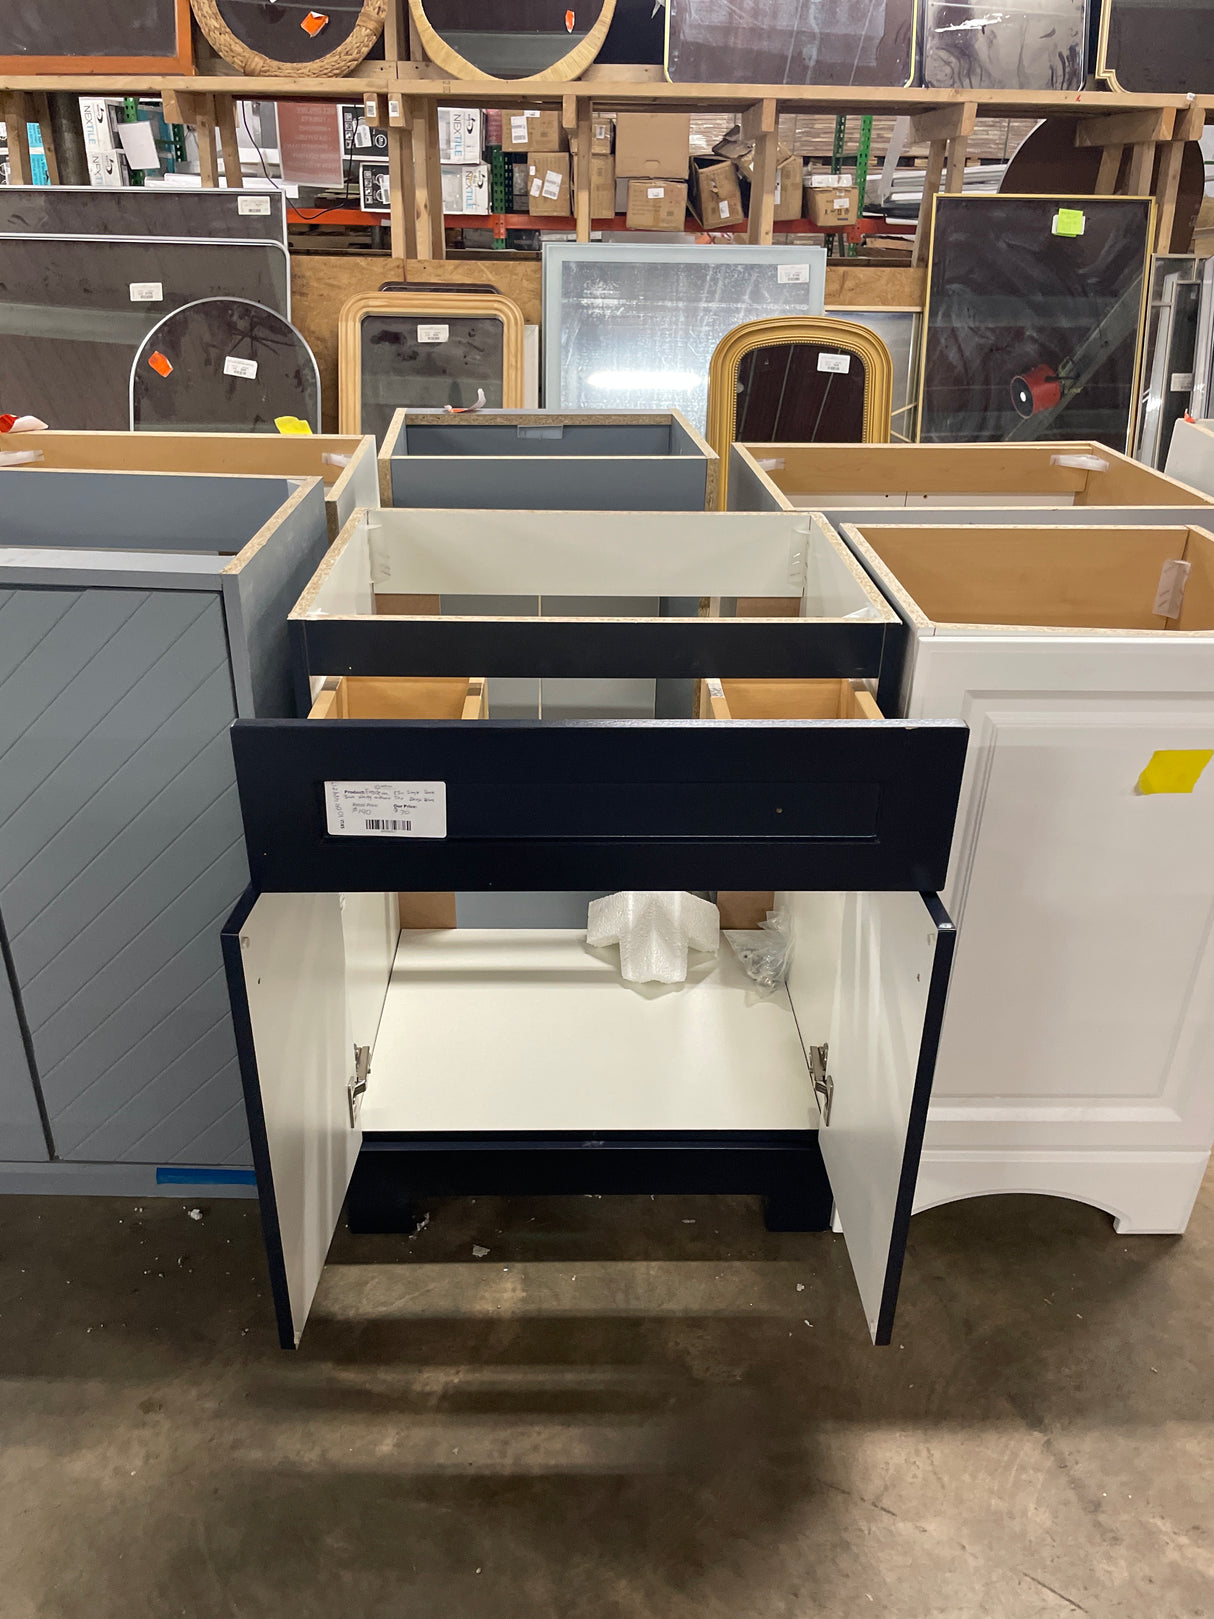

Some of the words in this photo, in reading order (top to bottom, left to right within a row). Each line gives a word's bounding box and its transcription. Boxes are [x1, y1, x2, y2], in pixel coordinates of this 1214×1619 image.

[83, 105, 96, 144] NEXTILE
[453, 113, 463, 157] NEXTILE
[92, 155, 103, 184] NEXTI
[465, 170, 474, 210] NEXTILE
